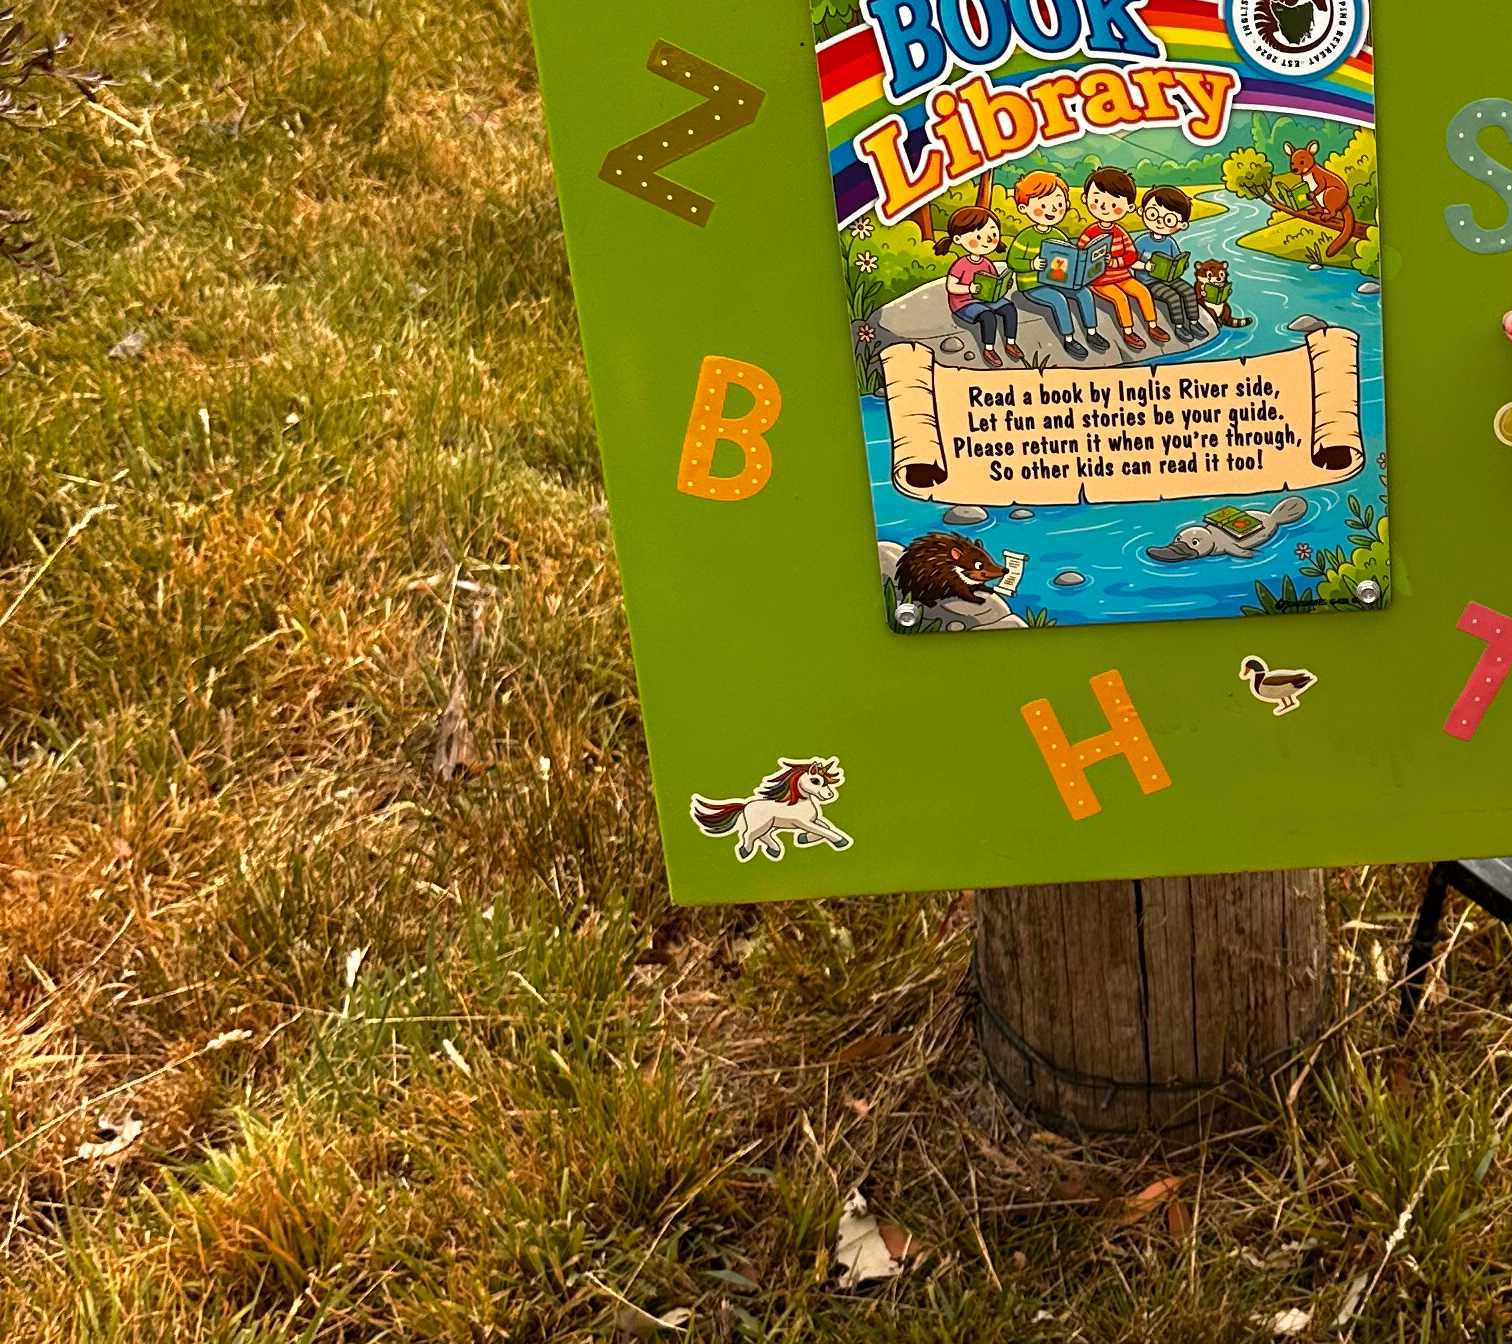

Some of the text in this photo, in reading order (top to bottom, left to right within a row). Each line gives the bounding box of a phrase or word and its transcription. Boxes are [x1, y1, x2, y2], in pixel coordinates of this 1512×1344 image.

[1240, 0, 1253, 36] INGLIS
[1308, 30, 1344, 66] RETREAT
[1256, 45, 1300, 68] EST 2024
[598, 40, 765, 227] Z
[861, 68, 1233, 220] Library
[968, 400, 1284, 432] Let fun and stories be your guide.
[969, 375, 1280, 409] Read a book by Inglis River side,
[676, 354, 783, 502] B
[954, 423, 1302, 458] Please return it when you're through,
[990, 449, 1263, 481] So other kids can read it too!
[1020, 668, 1173, 821] H
